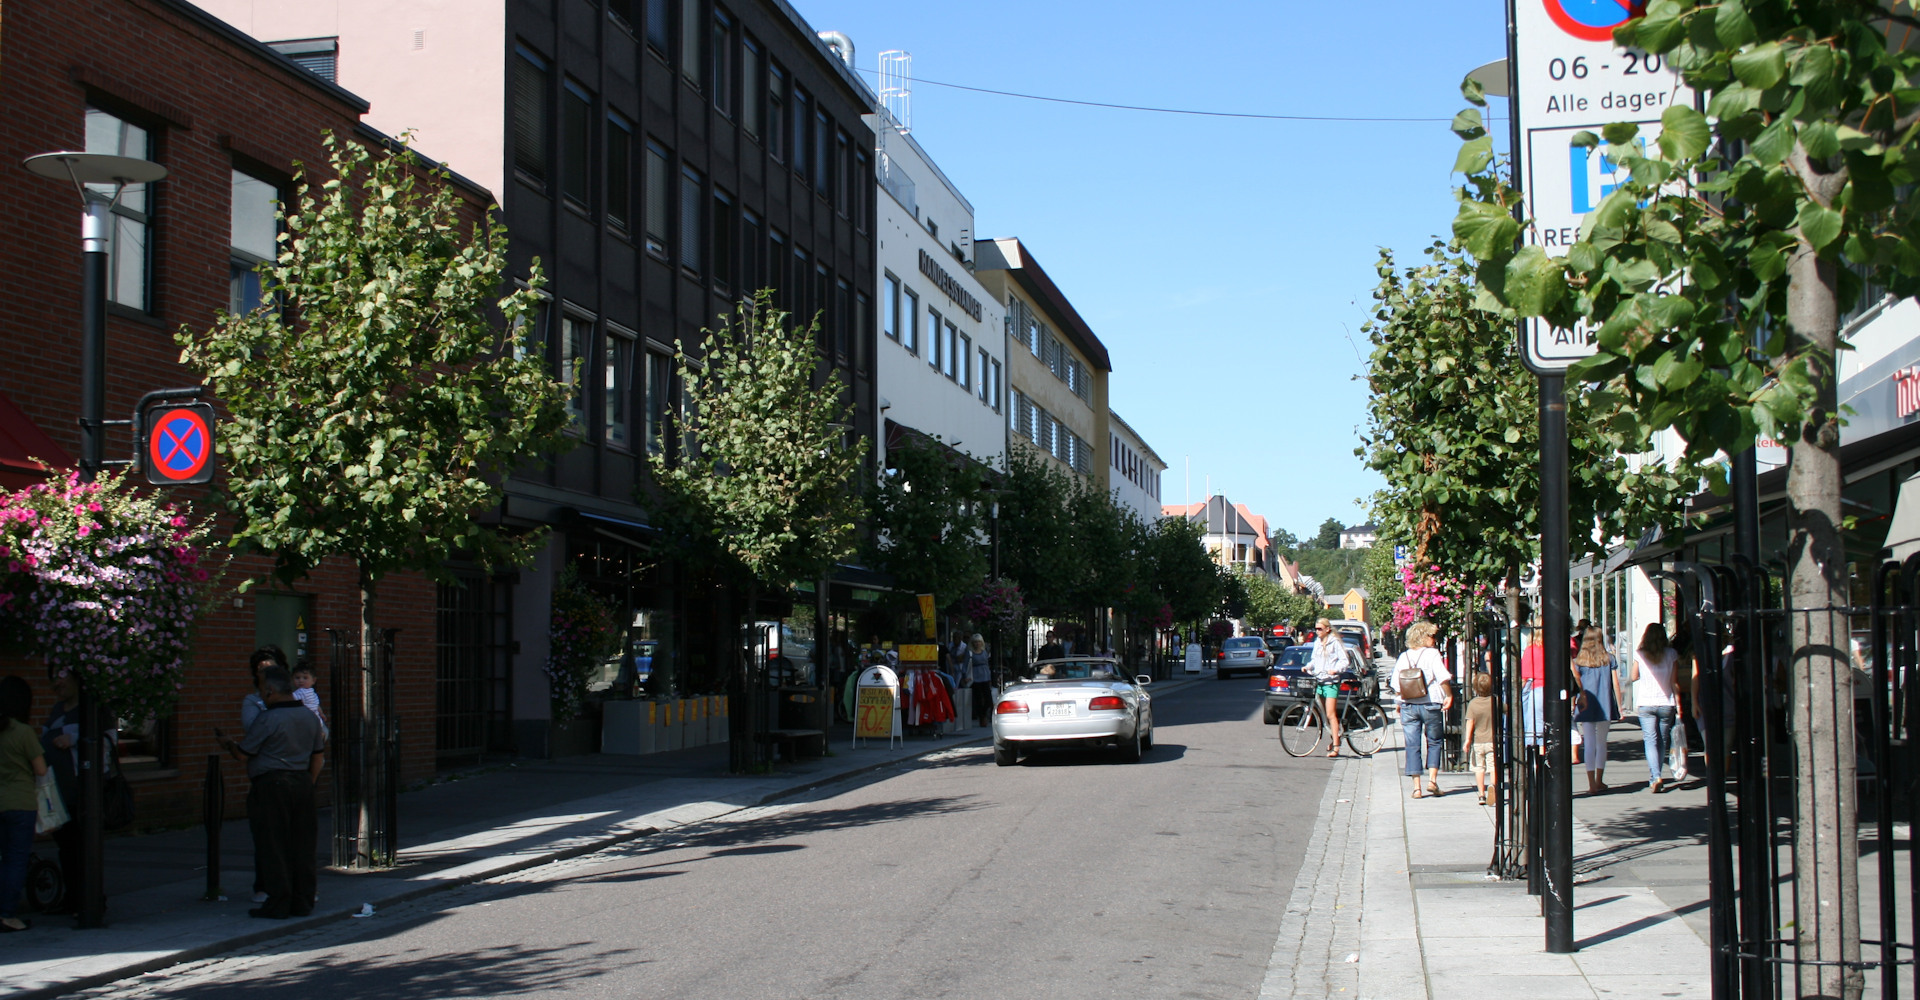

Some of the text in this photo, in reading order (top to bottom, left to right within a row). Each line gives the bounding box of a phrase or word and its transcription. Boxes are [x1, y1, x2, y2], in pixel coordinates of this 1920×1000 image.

[1548, 56, 1589, 81] 06
[1622, 52, 1662, 76] 20
[1546, 91, 1667, 114] Alle dager
